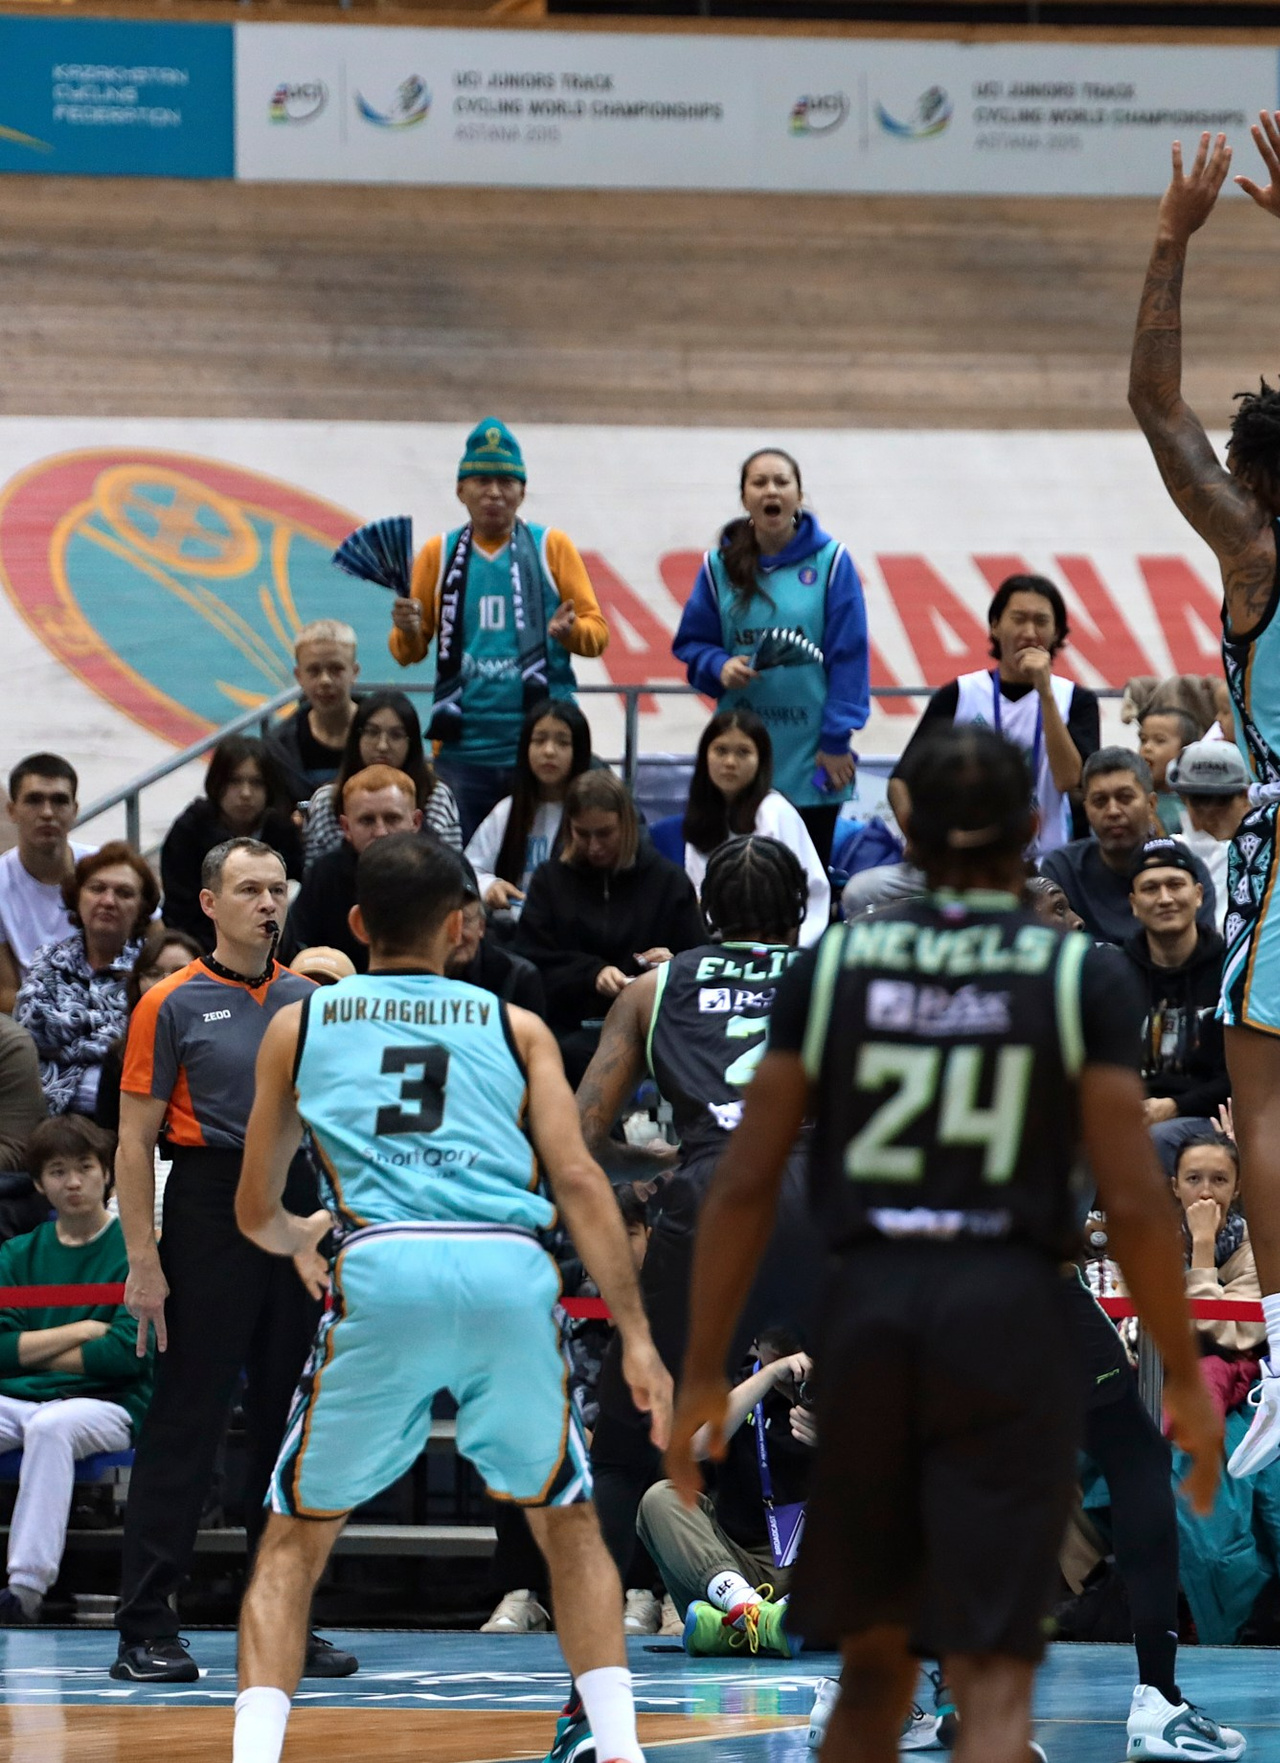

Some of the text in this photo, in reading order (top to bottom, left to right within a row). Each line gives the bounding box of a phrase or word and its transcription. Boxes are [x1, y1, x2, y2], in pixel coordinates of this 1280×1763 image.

[488, 71, 555, 89] JUNIORS
[438, 589, 460, 661] TEAM
[479, 595, 505, 630] 10
[845, 920, 1057, 976] NEVELS
[203, 1009, 231, 1023] ZEDO
[322, 996, 491, 1027] MURZAGALIYEV
[375, 1043, 451, 1137] 3
[844, 1042, 1034, 1186] 24
[768, 1515, 782, 1556] BROADCAST
